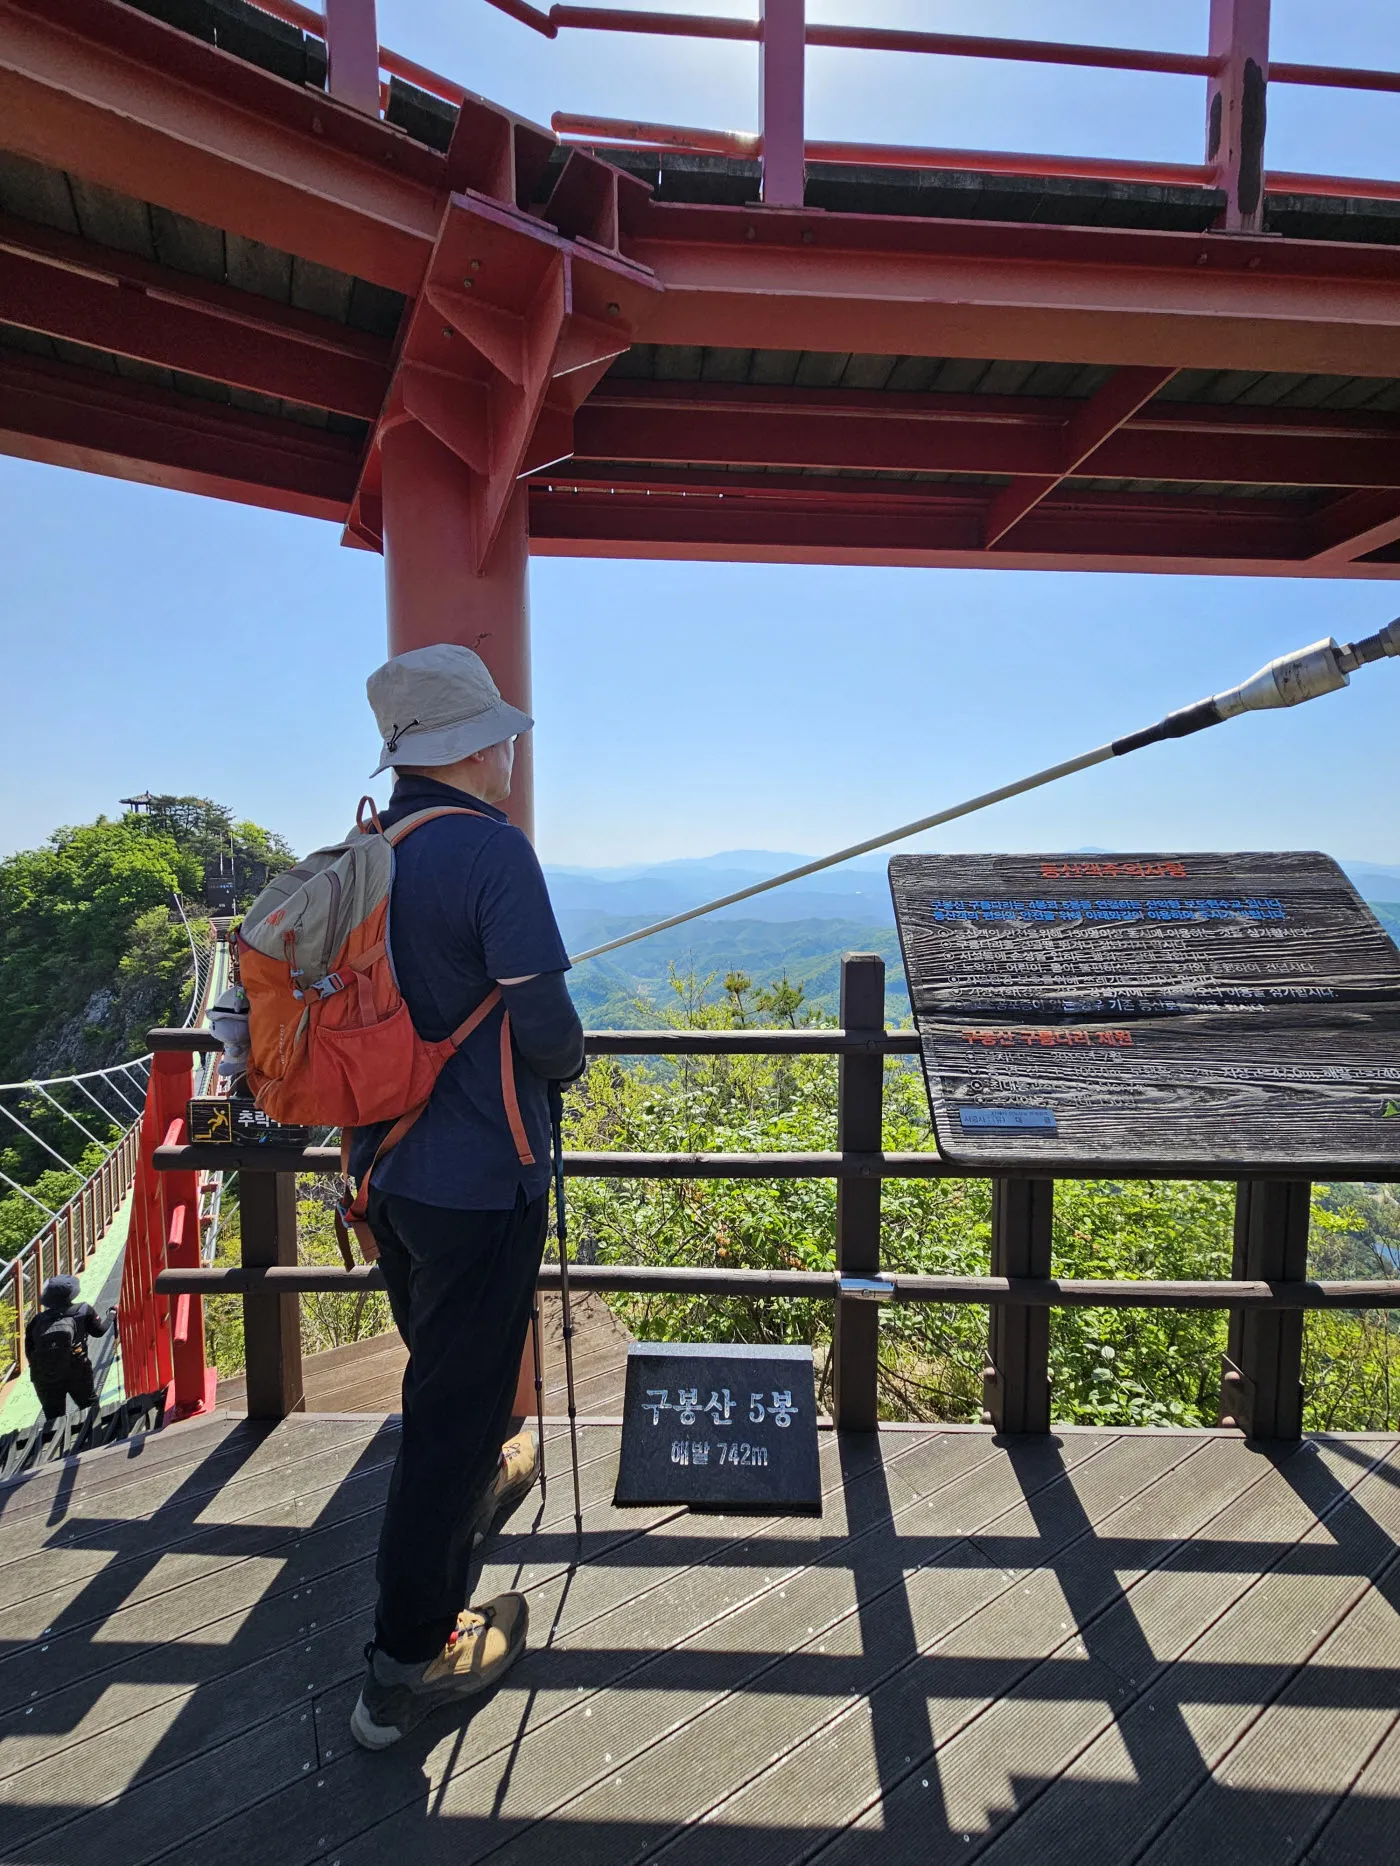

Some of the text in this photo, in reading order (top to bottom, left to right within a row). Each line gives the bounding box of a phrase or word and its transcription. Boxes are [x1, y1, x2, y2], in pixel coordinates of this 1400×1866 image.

[1041, 862, 1187, 879] 등산객주의사항
[932, 900, 970, 910] 구봉산
[975, 900, 1025, 910] 구름다리는
[1029, 900, 1058, 910] 4봉과
[1063, 900, 1091, 910] 5봉을
[1096, 900, 1142, 910] 연결하는
[935, 911, 980, 921] 등산객의
[984, 911, 1017, 921] 편의와
[1020, 911, 1055, 921] 안전을
[1060, 911, 1082, 921] 위해
[1147, 911, 1196, 921] 이용하여
[962, 1030, 1133, 1046] 구봉산 구름다리 제원
[641, 1388, 799, 1428] 구봉산 5봉
[671, 1440, 768, 1466] 해발 742m
